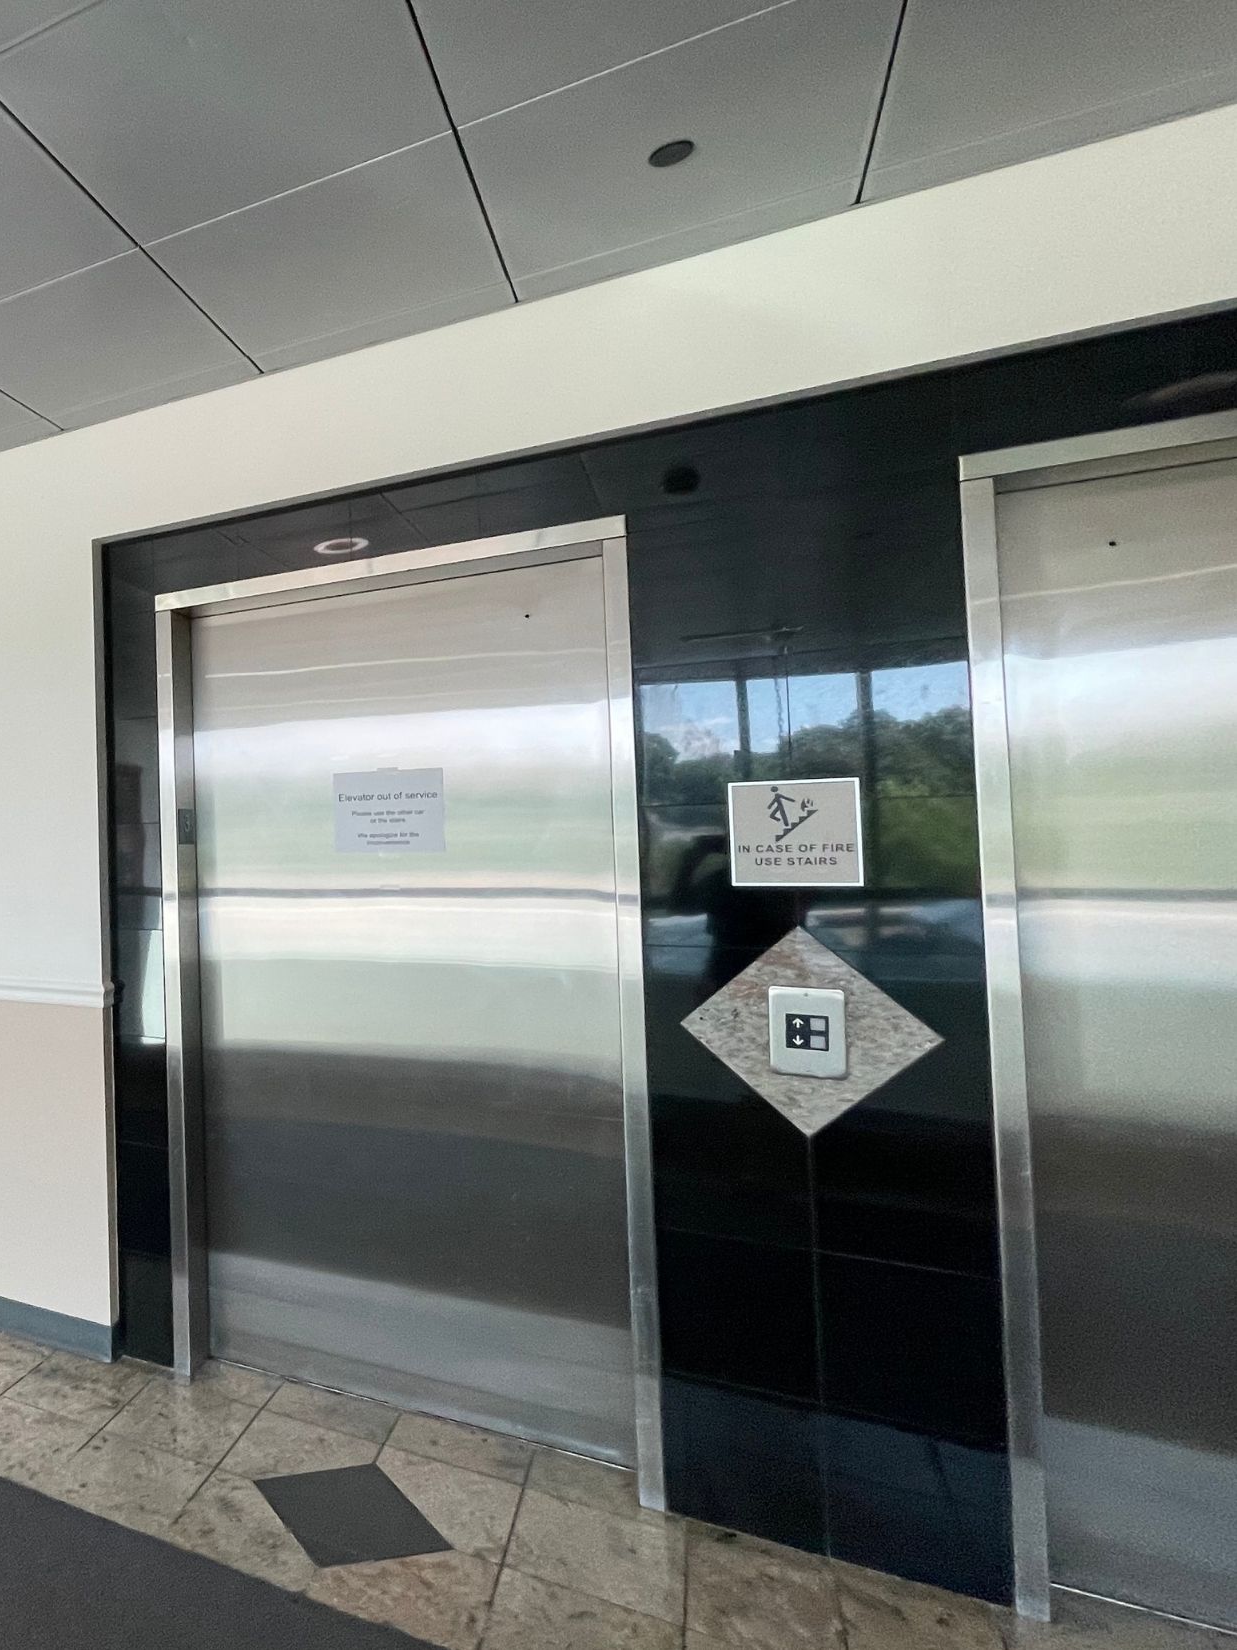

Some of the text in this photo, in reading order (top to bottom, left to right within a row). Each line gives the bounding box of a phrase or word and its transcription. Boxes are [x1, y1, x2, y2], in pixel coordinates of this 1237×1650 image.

[338, 790, 438, 802] Elevator out of service
[738, 843, 856, 853] IN CASE OF FIRE
[755, 856, 838, 866] USE STAIRS
